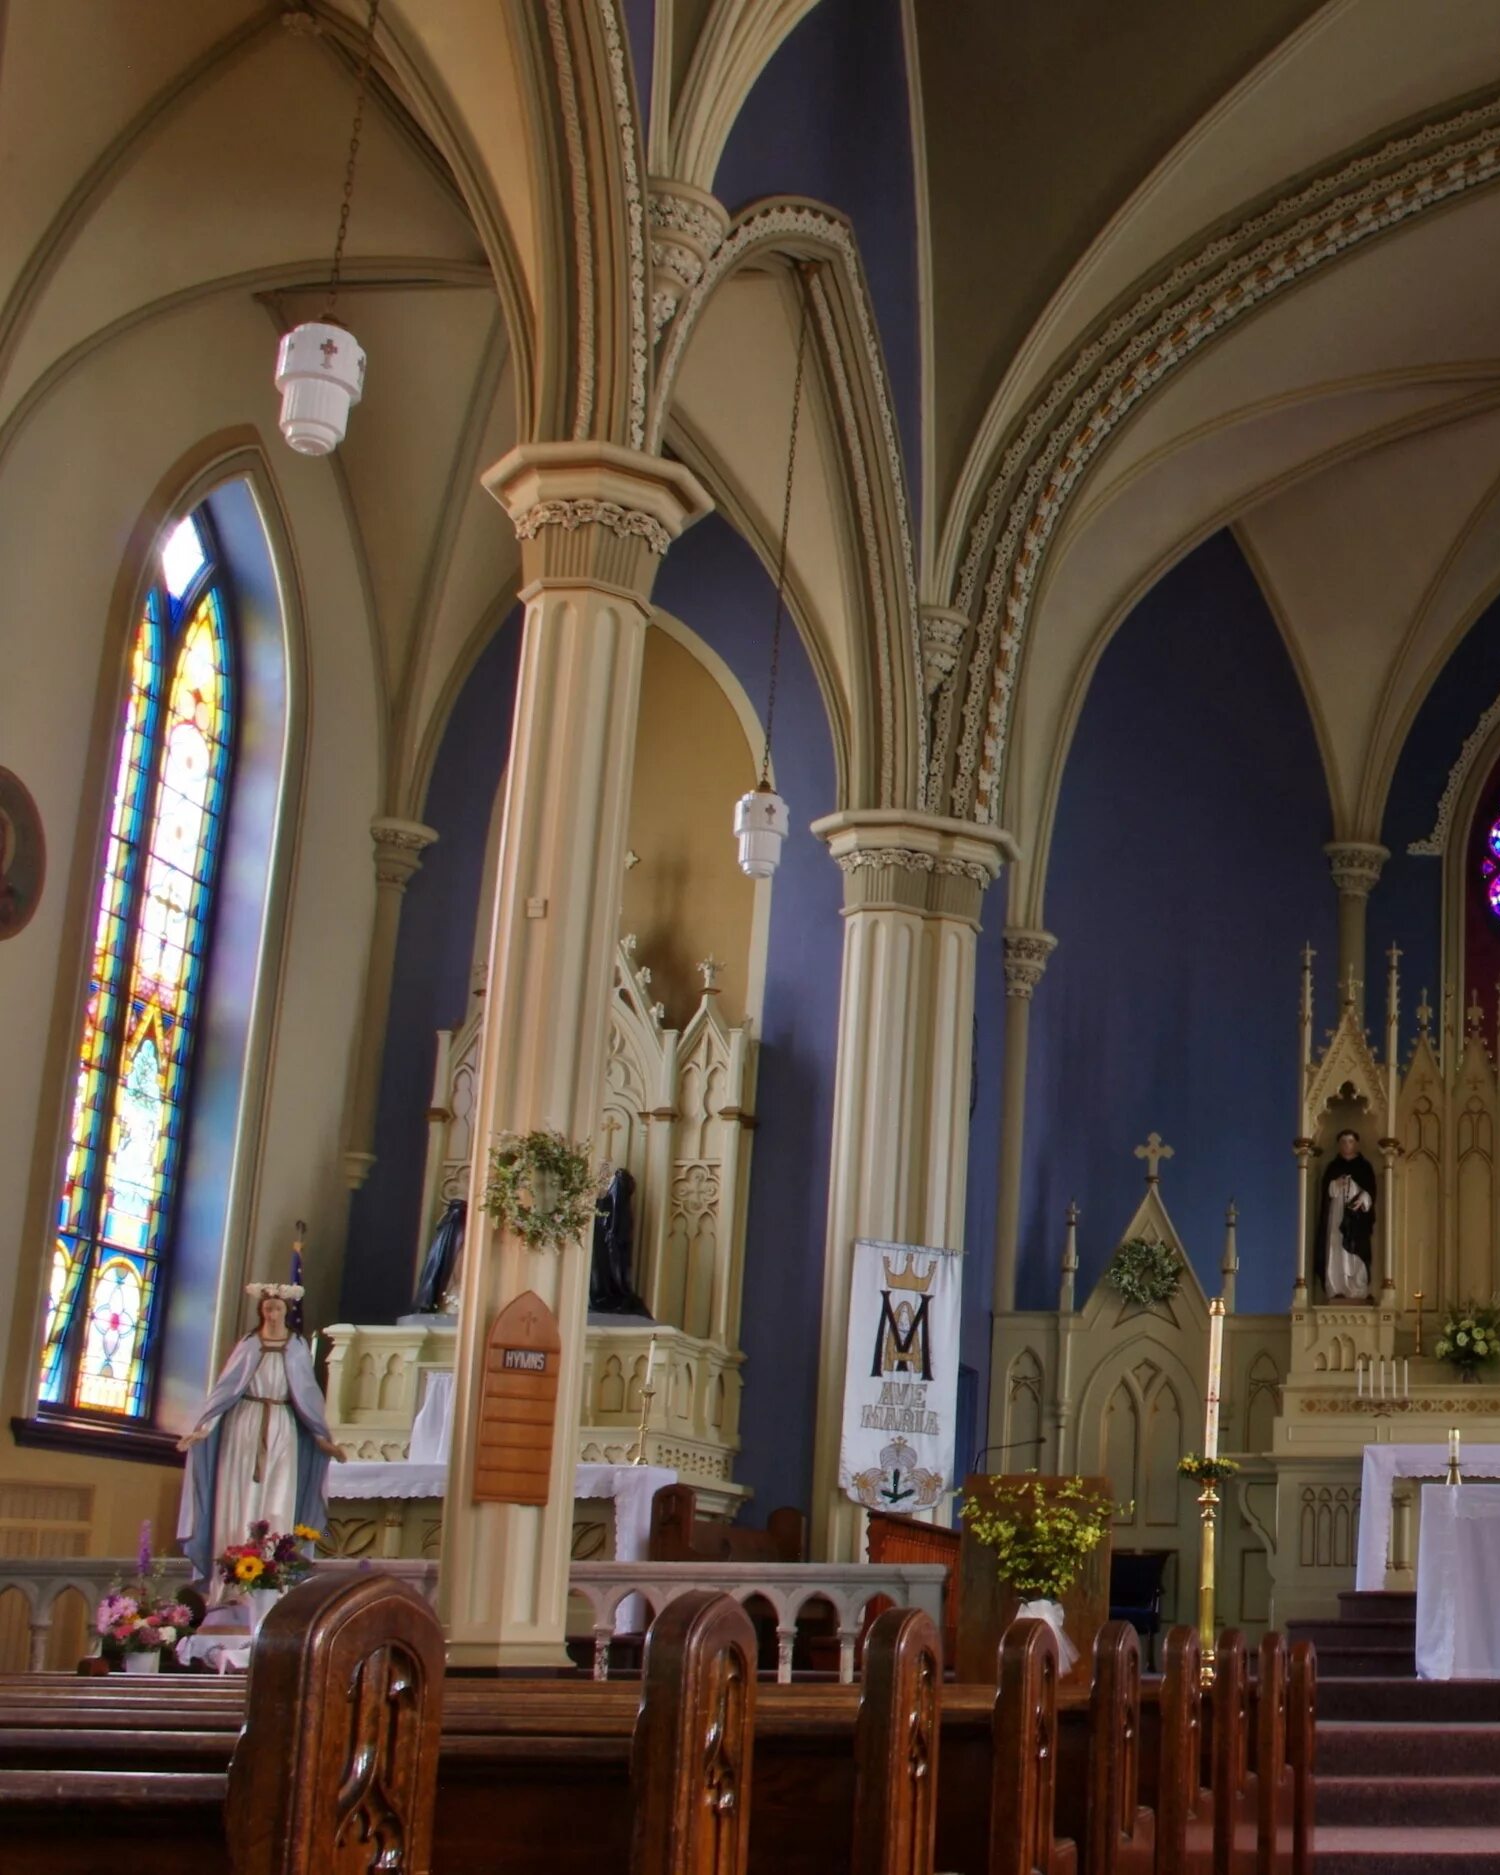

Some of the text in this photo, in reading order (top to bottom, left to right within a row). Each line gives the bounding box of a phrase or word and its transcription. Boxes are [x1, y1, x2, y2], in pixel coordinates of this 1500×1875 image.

[505, 1350, 545, 1370] HYMNS
[879, 1382, 928, 1409] AVE
[860, 1404, 939, 1436] MARIA
